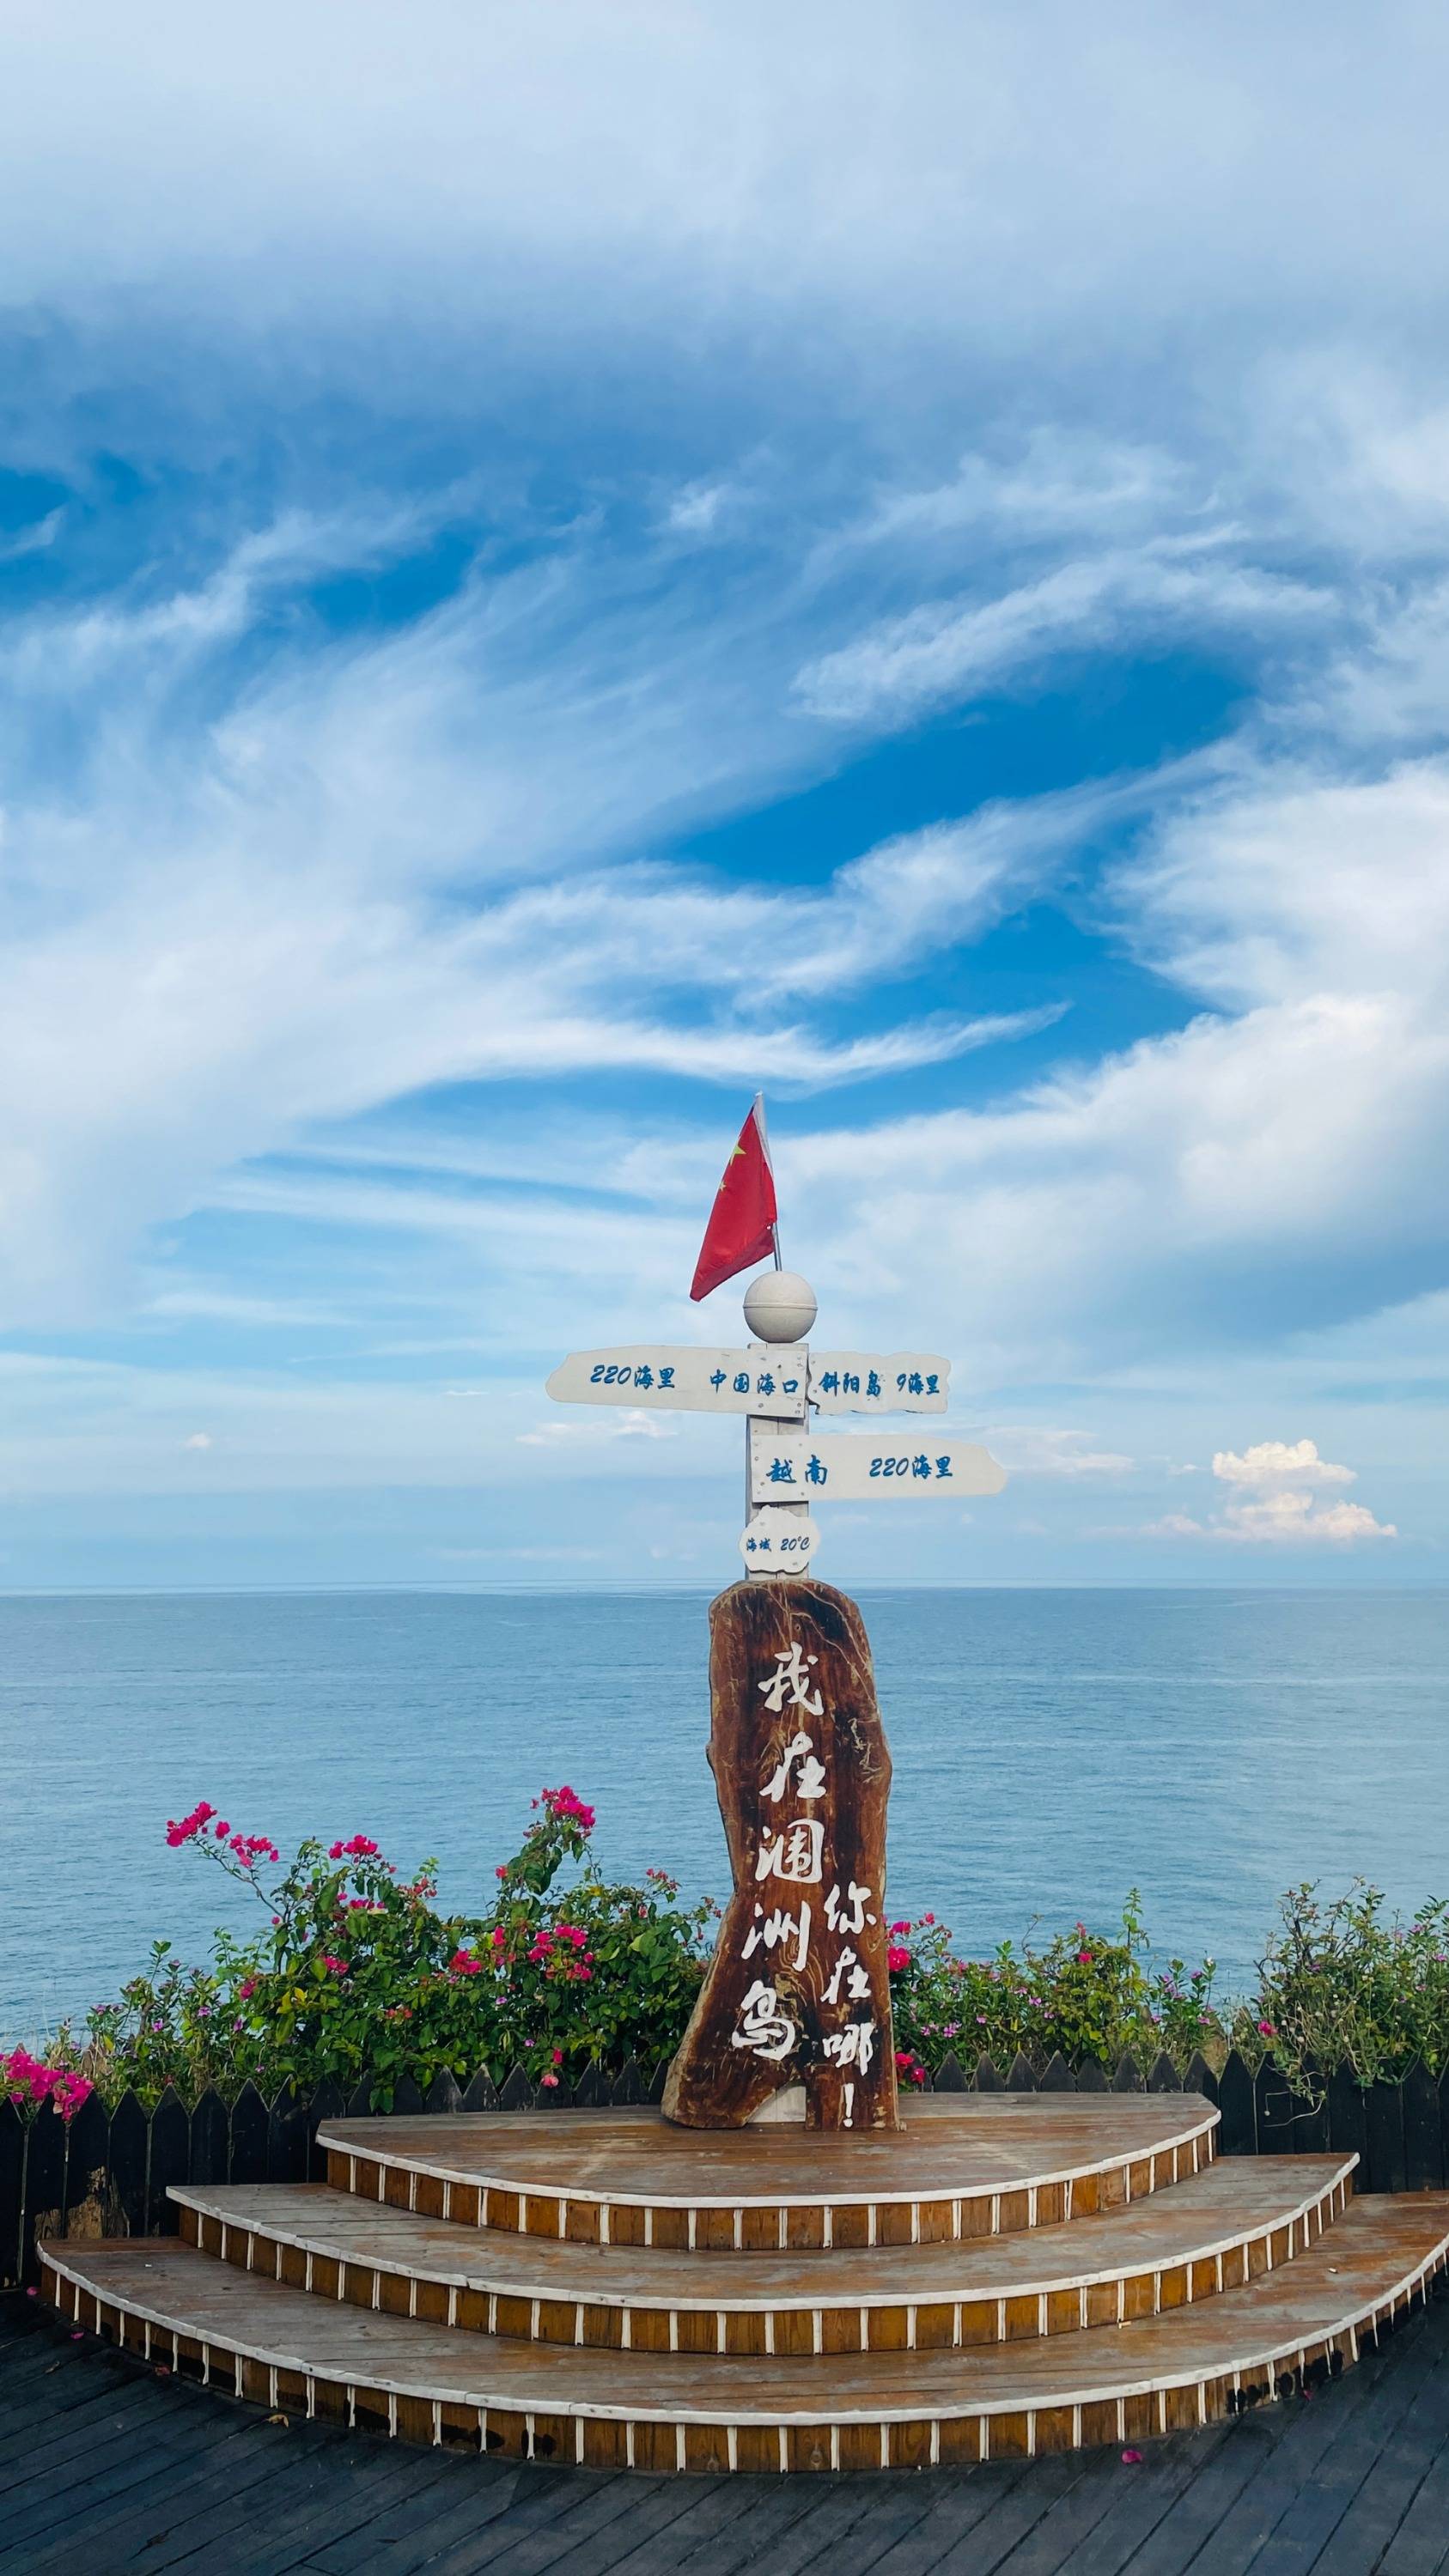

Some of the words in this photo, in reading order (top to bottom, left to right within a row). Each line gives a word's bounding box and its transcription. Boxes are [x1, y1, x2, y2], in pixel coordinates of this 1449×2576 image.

[590, 1364, 675, 1389] 220海里
[710, 1369, 798, 1395] 中国海口
[819, 1370, 881, 1397] 斜阳岛
[897, 1373, 941, 1395] 9海里
[766, 1454, 828, 1485] 越南
[869, 1454, 953, 1479] 220海里
[733, 1641, 826, 2061] 我在涠洲岛
